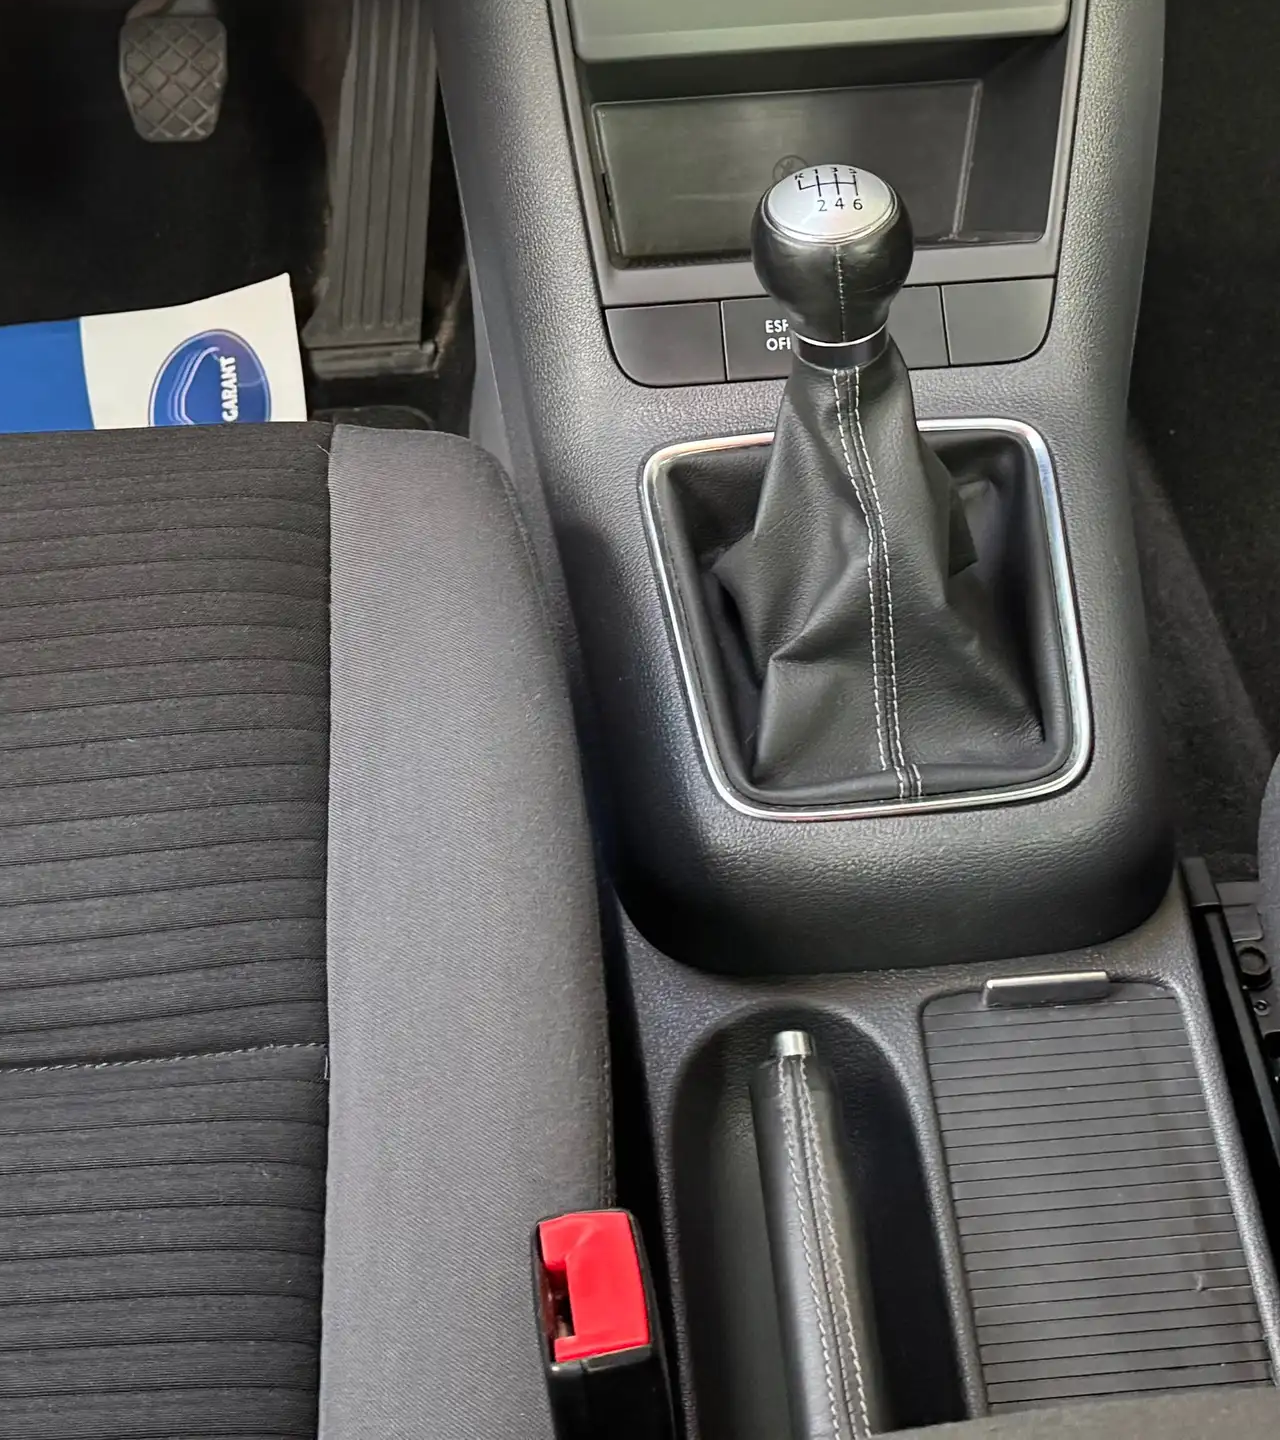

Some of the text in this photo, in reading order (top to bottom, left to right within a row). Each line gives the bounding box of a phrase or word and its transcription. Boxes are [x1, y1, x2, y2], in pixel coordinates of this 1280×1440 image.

[817, 197, 863, 212] 2 4 6
[219, 355, 239, 422] GARANT
